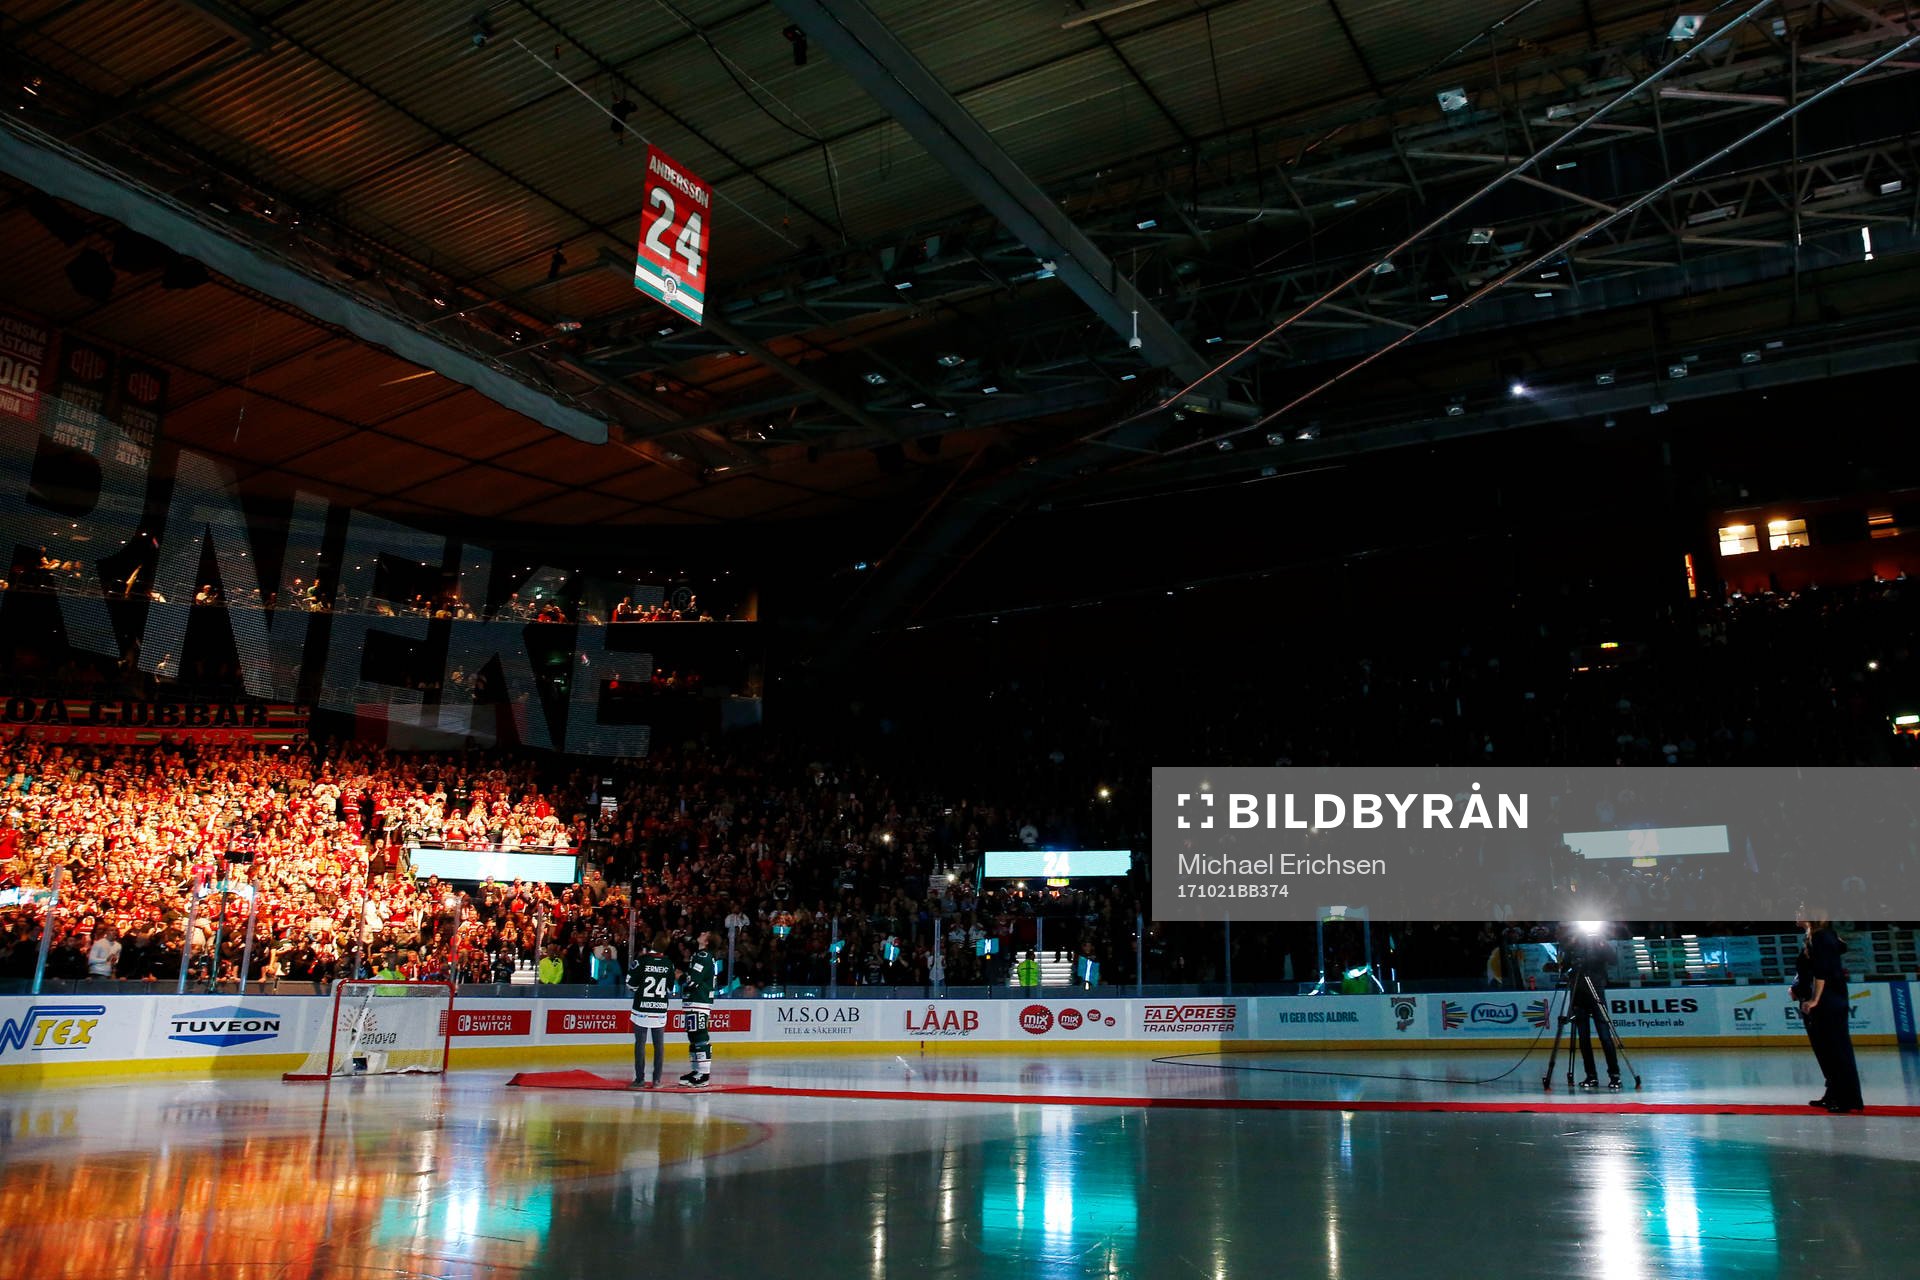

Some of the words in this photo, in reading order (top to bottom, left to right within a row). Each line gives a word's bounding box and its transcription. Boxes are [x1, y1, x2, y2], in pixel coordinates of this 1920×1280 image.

[649, 155, 709, 208] ANDERSSON
[645, 186, 702, 277] 24
[128, 370, 161, 401] CHL
[90, 701, 269, 727] GUBBAR
[1043, 852, 1069, 877] 24
[643, 976, 667, 998] 24
[1611, 998, 1698, 1014] BILLES
[777, 1007, 829, 1022] M.S.O
[833, 1007, 860, 1022] AB
[906, 1004, 979, 1030] LÅAB
[1024, 1013, 1048, 1025] mix
[1061, 1014, 1079, 1023] mix
[1279, 1012, 1289, 1022] VI
[1289, 1012, 1306, 1022] GER
[1307, 1012, 1325, 1022] OSS
[1477, 1009, 1512, 1017] VIDAL
[1734, 1007, 1754, 1020] EY
[171, 1021, 280, 1033] TUVEON
[472, 1021, 512, 1031] SWITCH
[577, 1020, 617, 1030] SWITCH
[1143, 1024, 1234, 1032] TRANSPORTER
[1613, 1019, 1636, 1027] Billes
[1638, 1018, 1671, 1028] Tryckeri
[1673, 1018, 1684, 1027] ab
